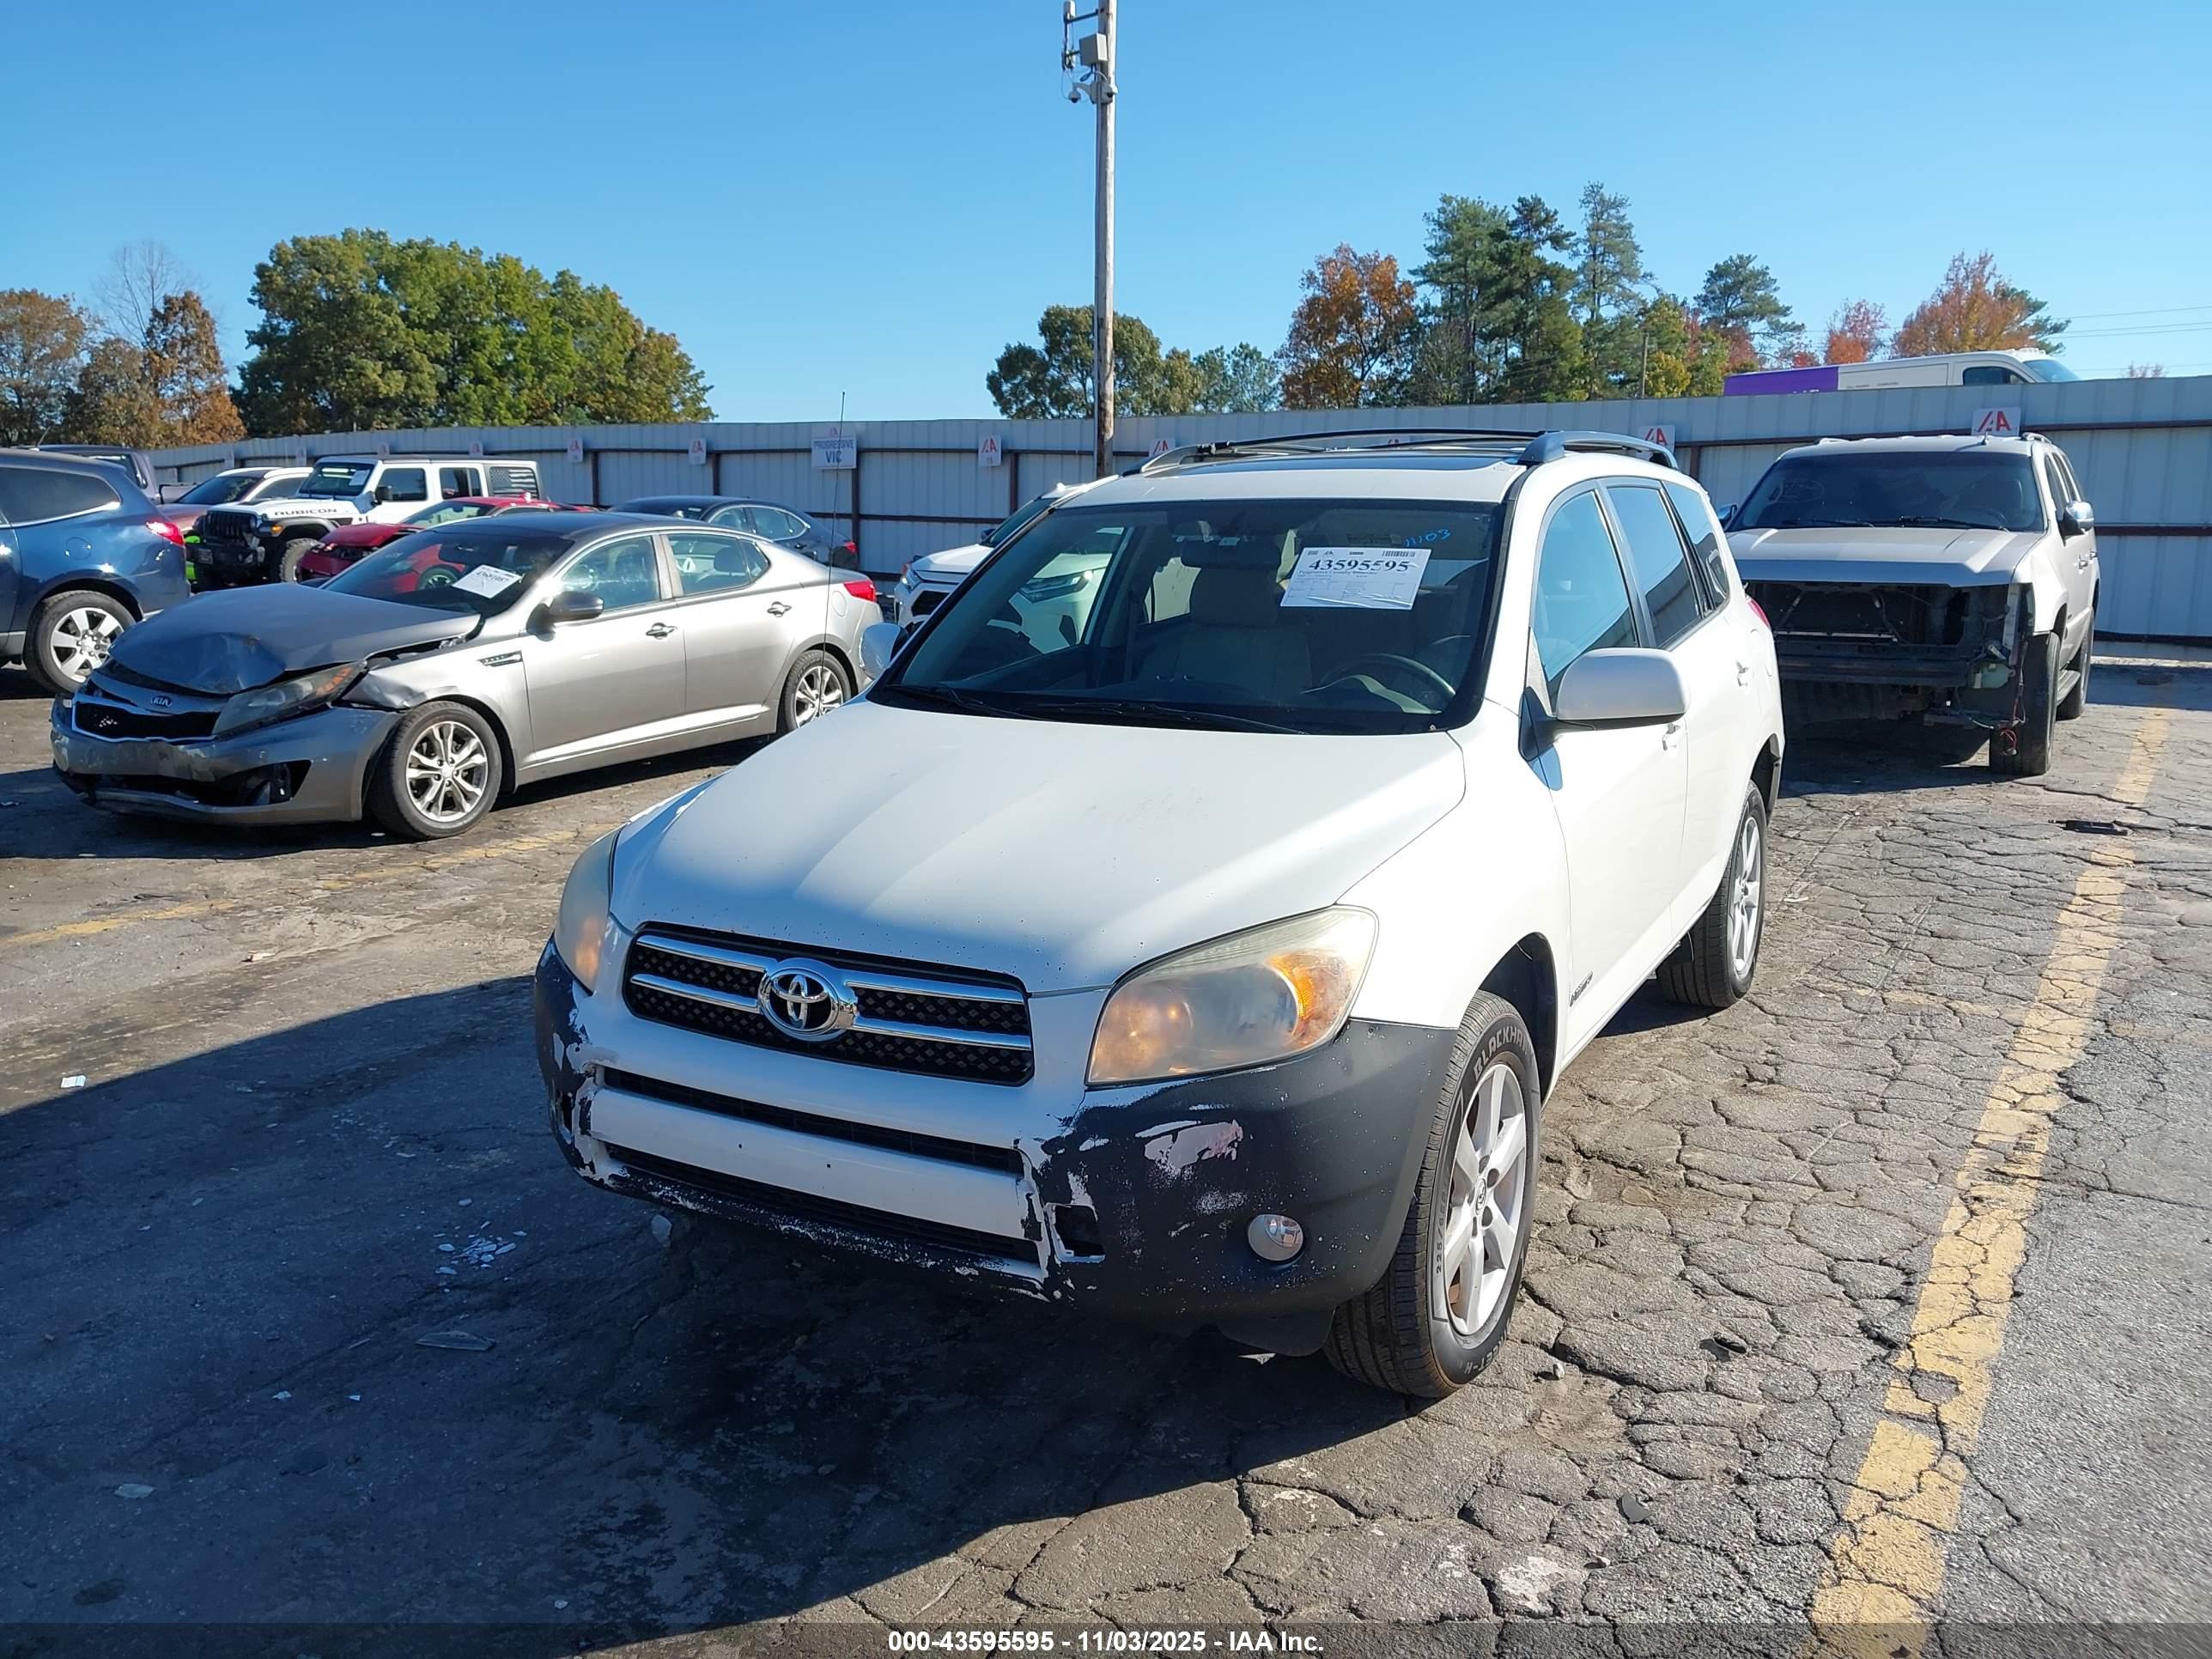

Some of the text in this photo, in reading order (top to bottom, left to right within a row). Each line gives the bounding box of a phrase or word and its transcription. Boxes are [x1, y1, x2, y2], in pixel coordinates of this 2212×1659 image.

[824, 450, 843, 464] VIC
[1308, 558, 1411, 573] 43595595
[153, 696, 171, 708] KIA
[1473, 1024, 1530, 1083] BLACKHA
